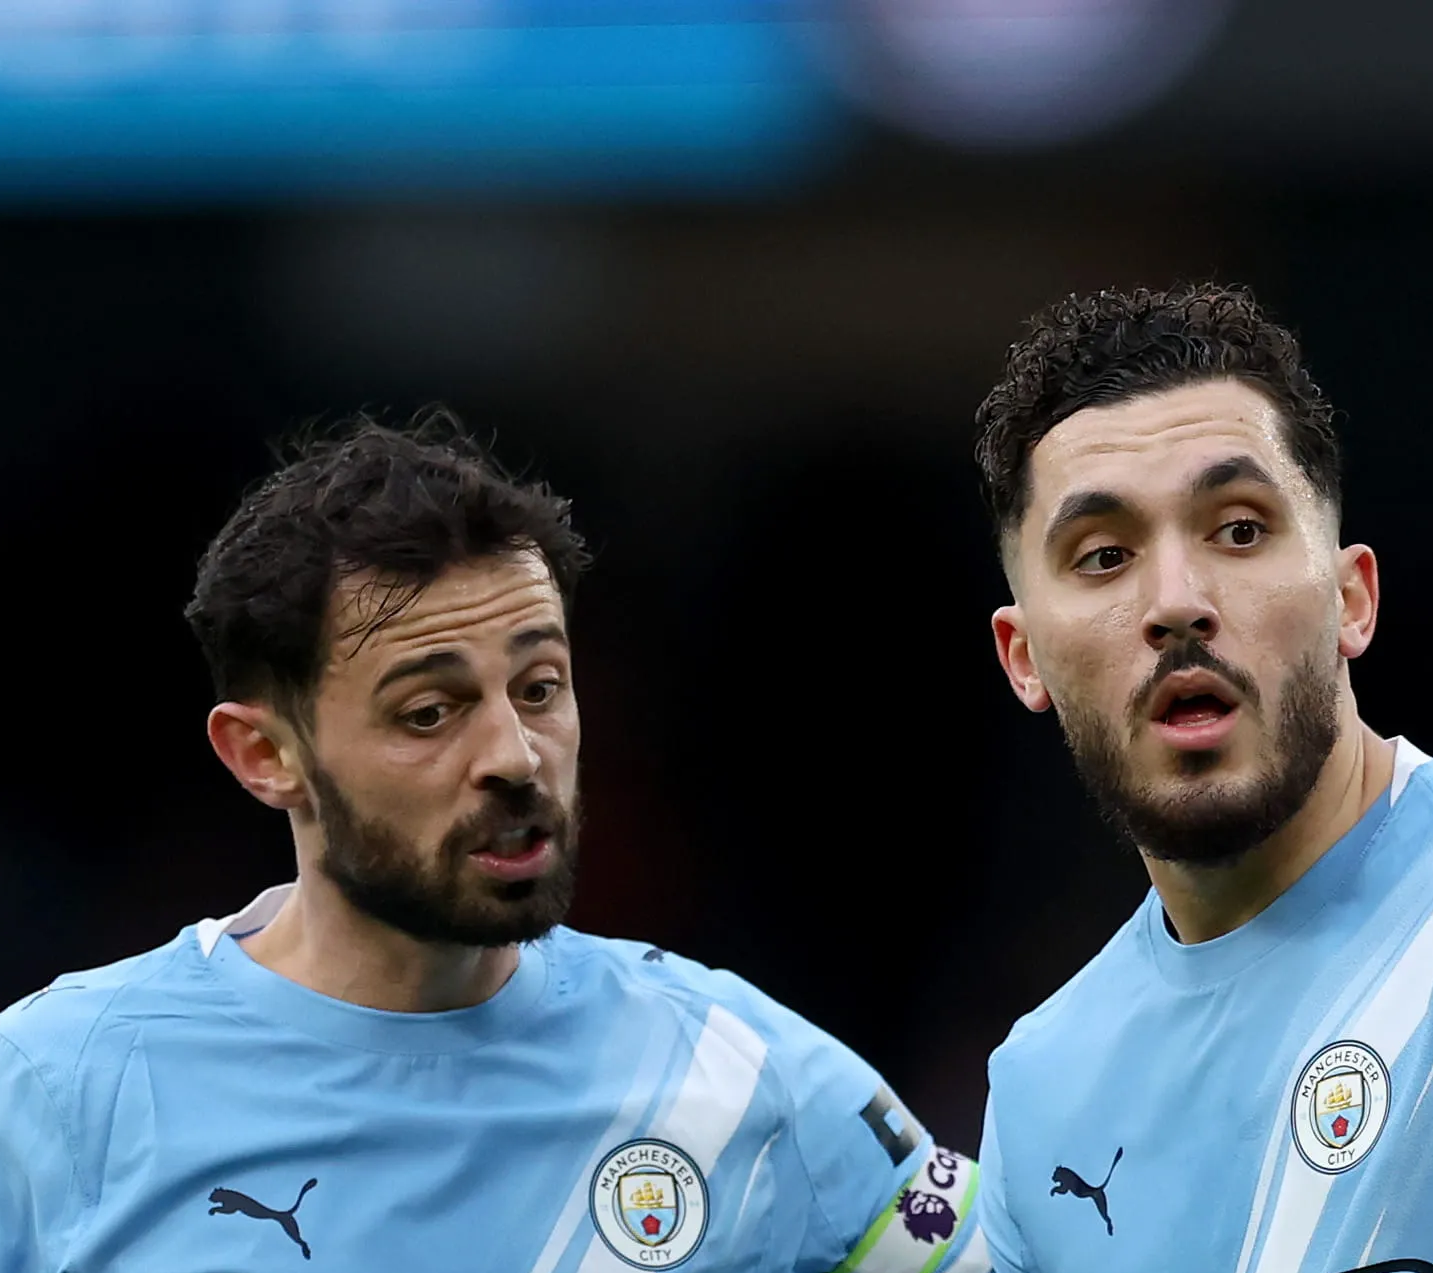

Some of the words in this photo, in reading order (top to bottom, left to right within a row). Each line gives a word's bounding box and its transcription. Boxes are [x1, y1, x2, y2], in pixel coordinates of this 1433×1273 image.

[1301, 1050, 1380, 1098] MANCHESTER
[601, 1149, 695, 1191] MANCHESTER
[1327, 1148, 1356, 1165] CITY
[639, 1249, 672, 1261] CITY
